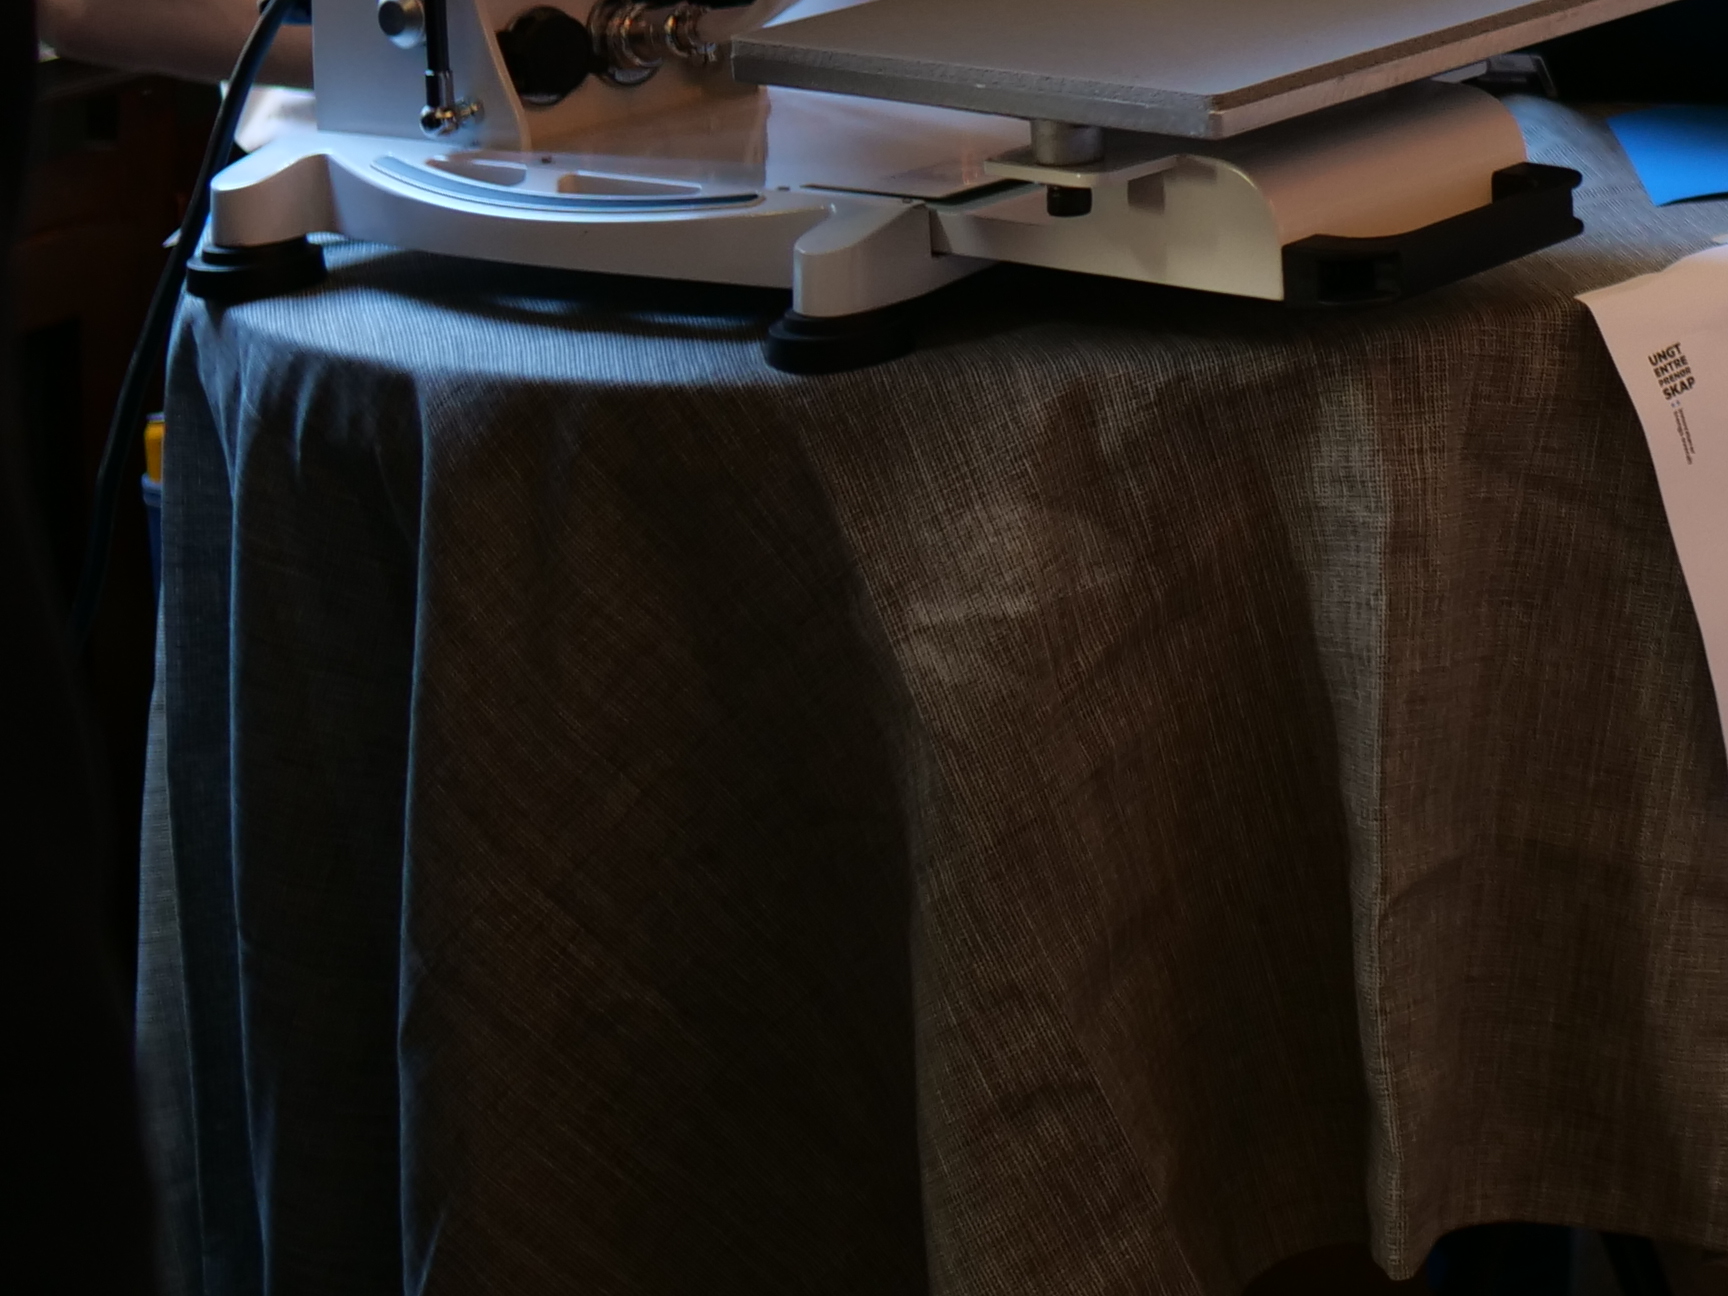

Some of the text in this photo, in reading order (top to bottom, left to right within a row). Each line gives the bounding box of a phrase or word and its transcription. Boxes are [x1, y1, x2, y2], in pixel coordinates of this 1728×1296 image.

[1648, 342, 1682, 366] UNGT
[1653, 355, 1688, 378] ENTRE
[1663, 376, 1696, 400] SKAP
